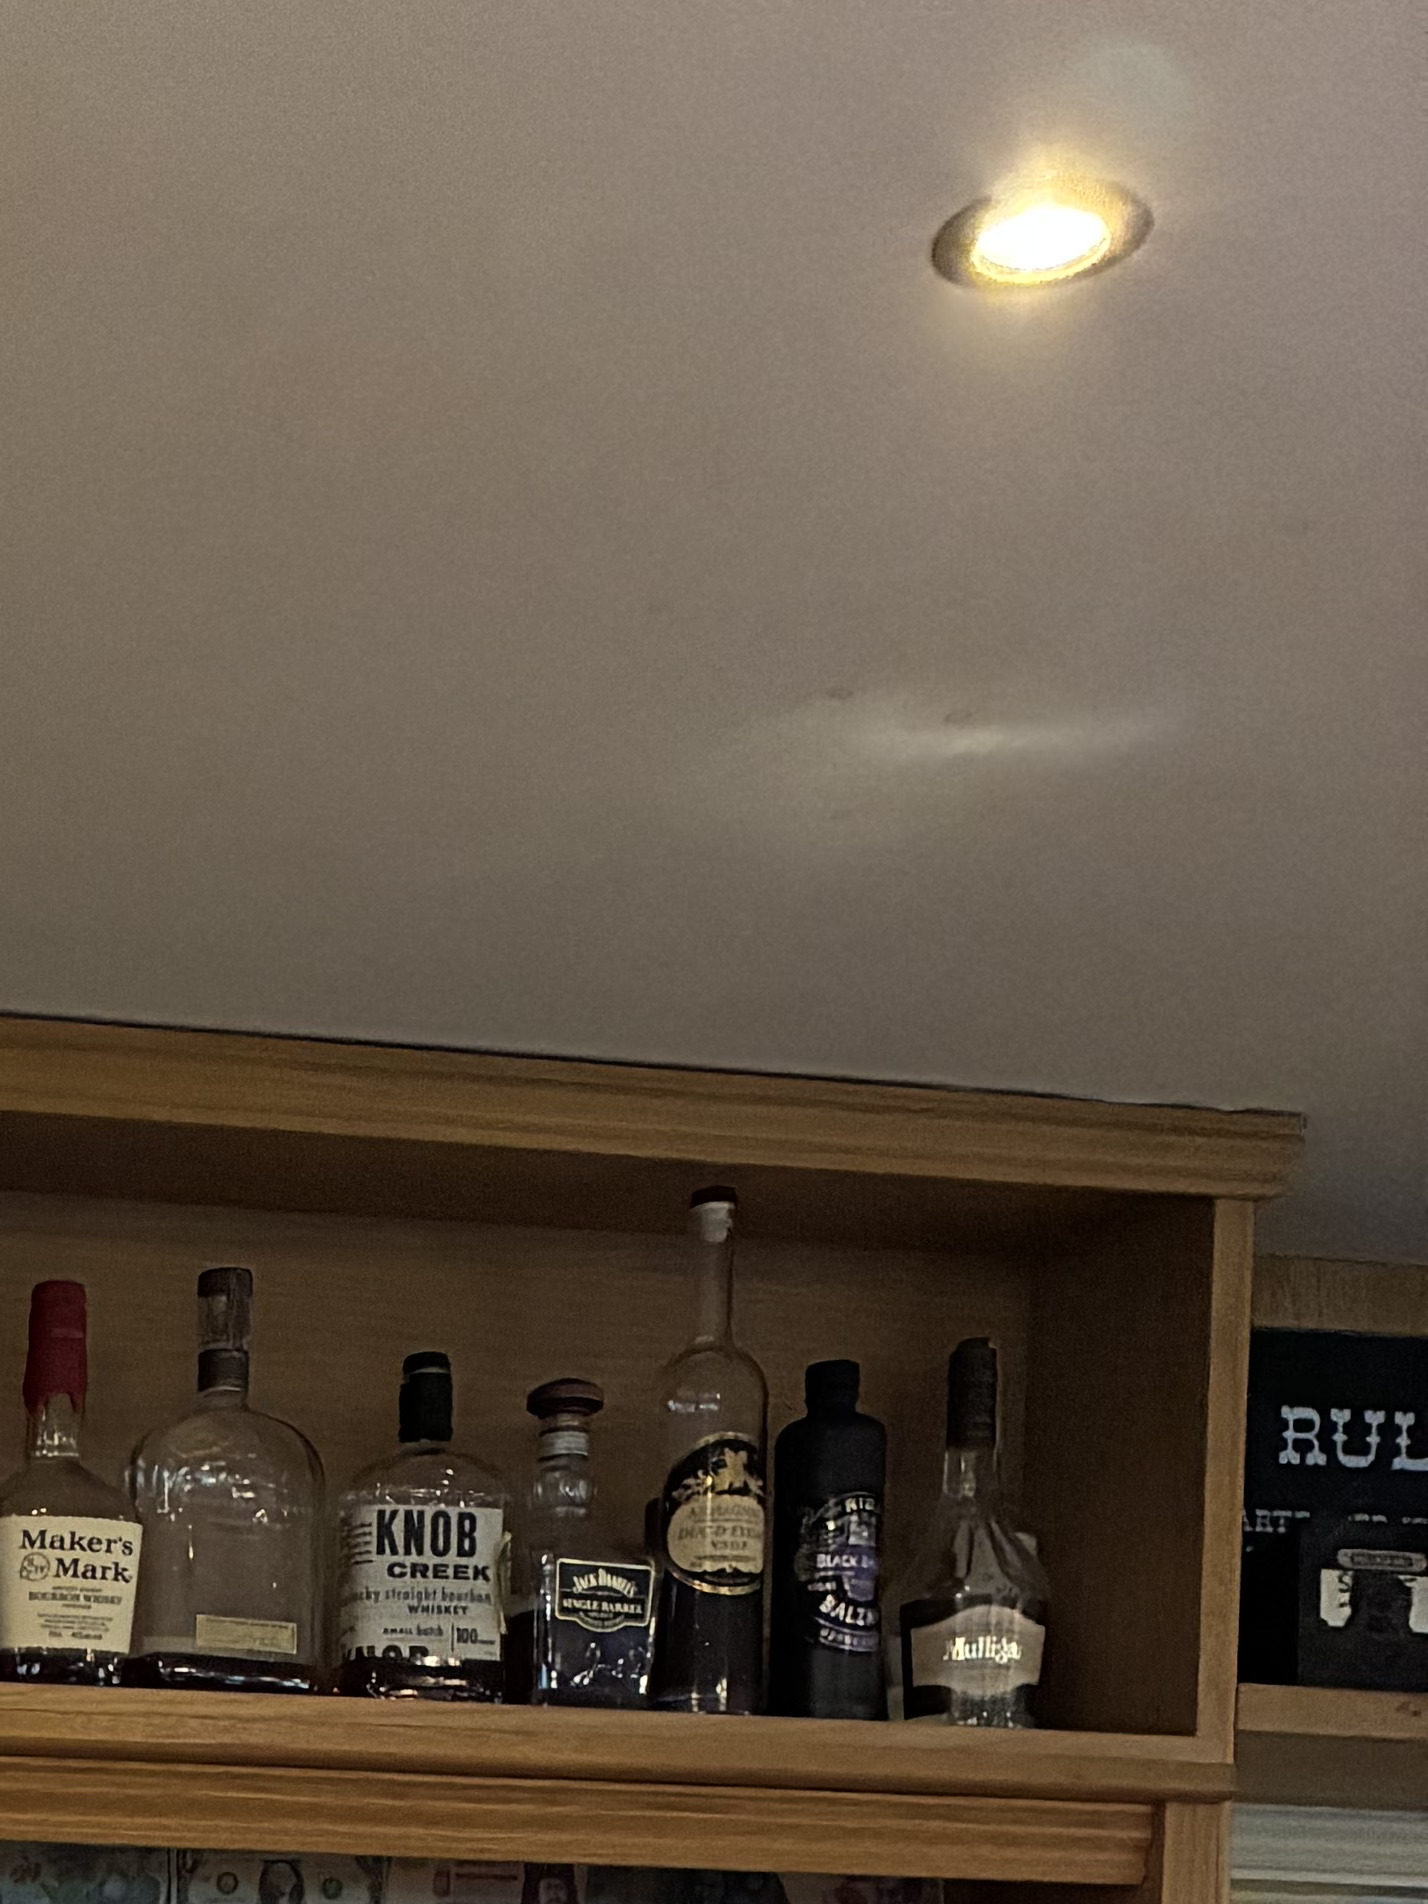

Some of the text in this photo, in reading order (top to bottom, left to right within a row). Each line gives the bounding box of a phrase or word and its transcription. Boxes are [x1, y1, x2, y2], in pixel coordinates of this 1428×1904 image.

[18, 1528, 134, 1557] Maker's
[375, 1508, 478, 1558] KNOB
[52, 1557, 132, 1584] Mark
[386, 1562, 491, 1582] CREEK
[942, 1635, 1023, 1665] Mulliga
